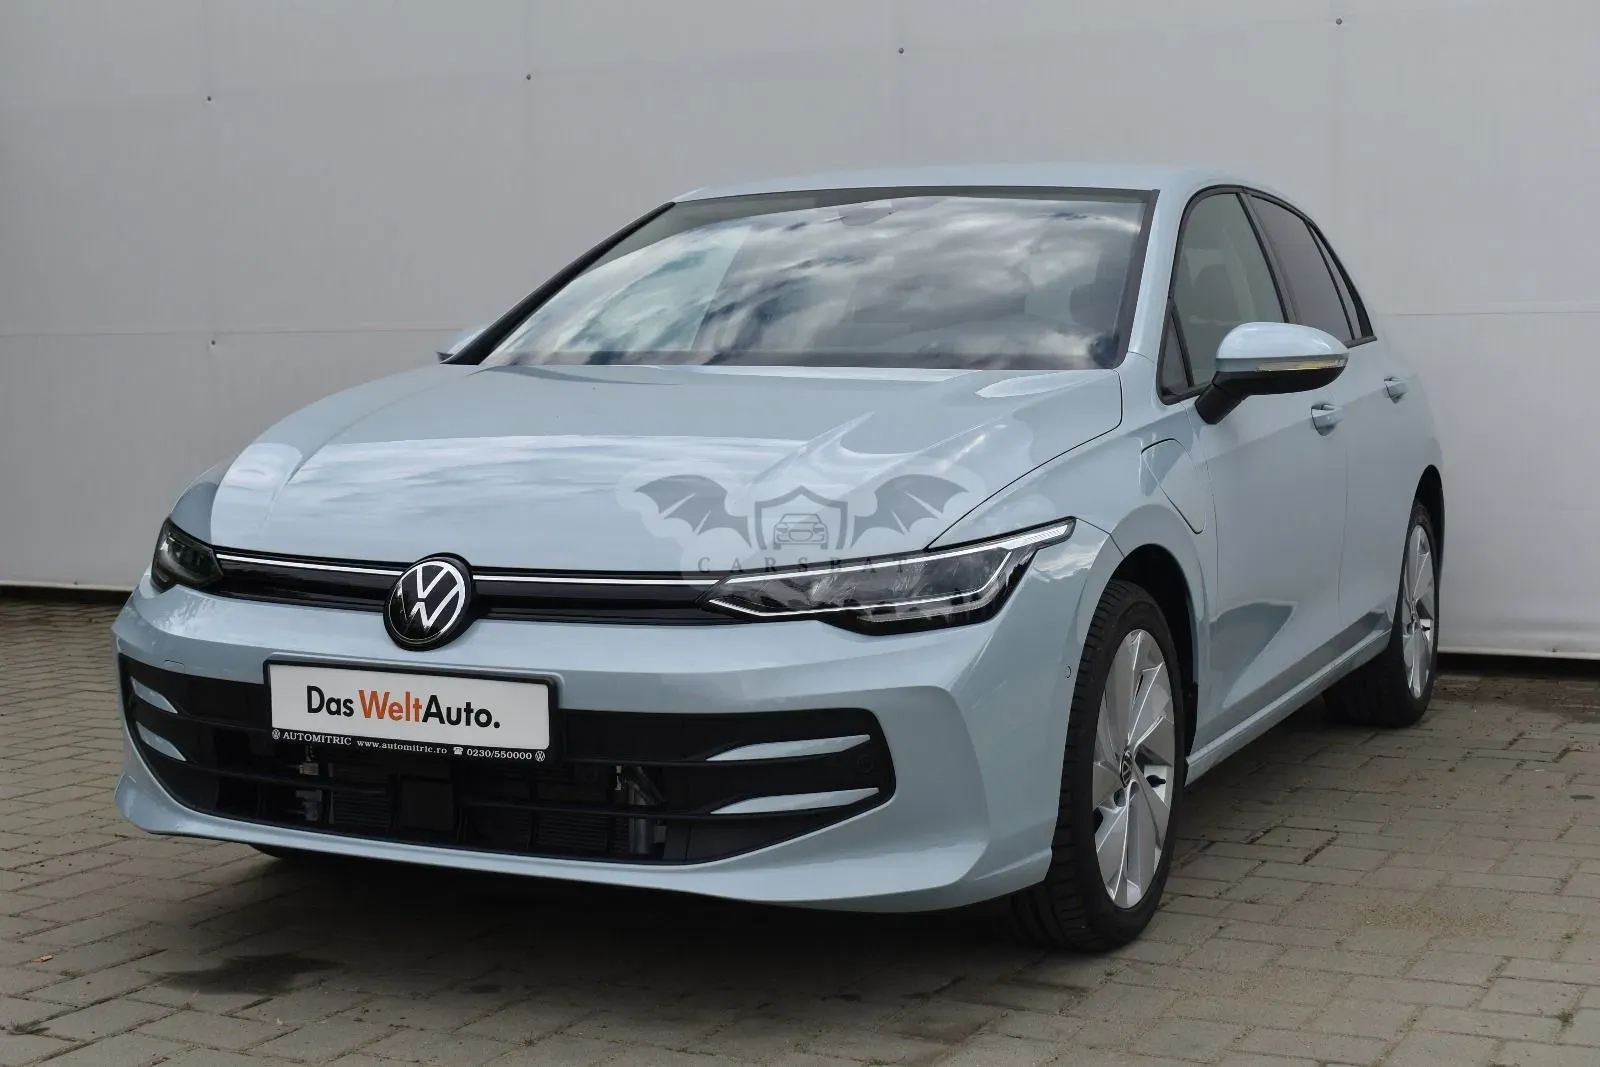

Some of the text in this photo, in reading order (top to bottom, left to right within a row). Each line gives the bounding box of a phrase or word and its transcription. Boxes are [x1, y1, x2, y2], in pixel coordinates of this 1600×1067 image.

[306, 685, 501, 729] Das WeltAuto.
[282, 732, 352, 746] AUTOMITRIC
[356, 739, 448, 754] www.automitric.ro
[466, 748, 533, 760] 0230/550000
